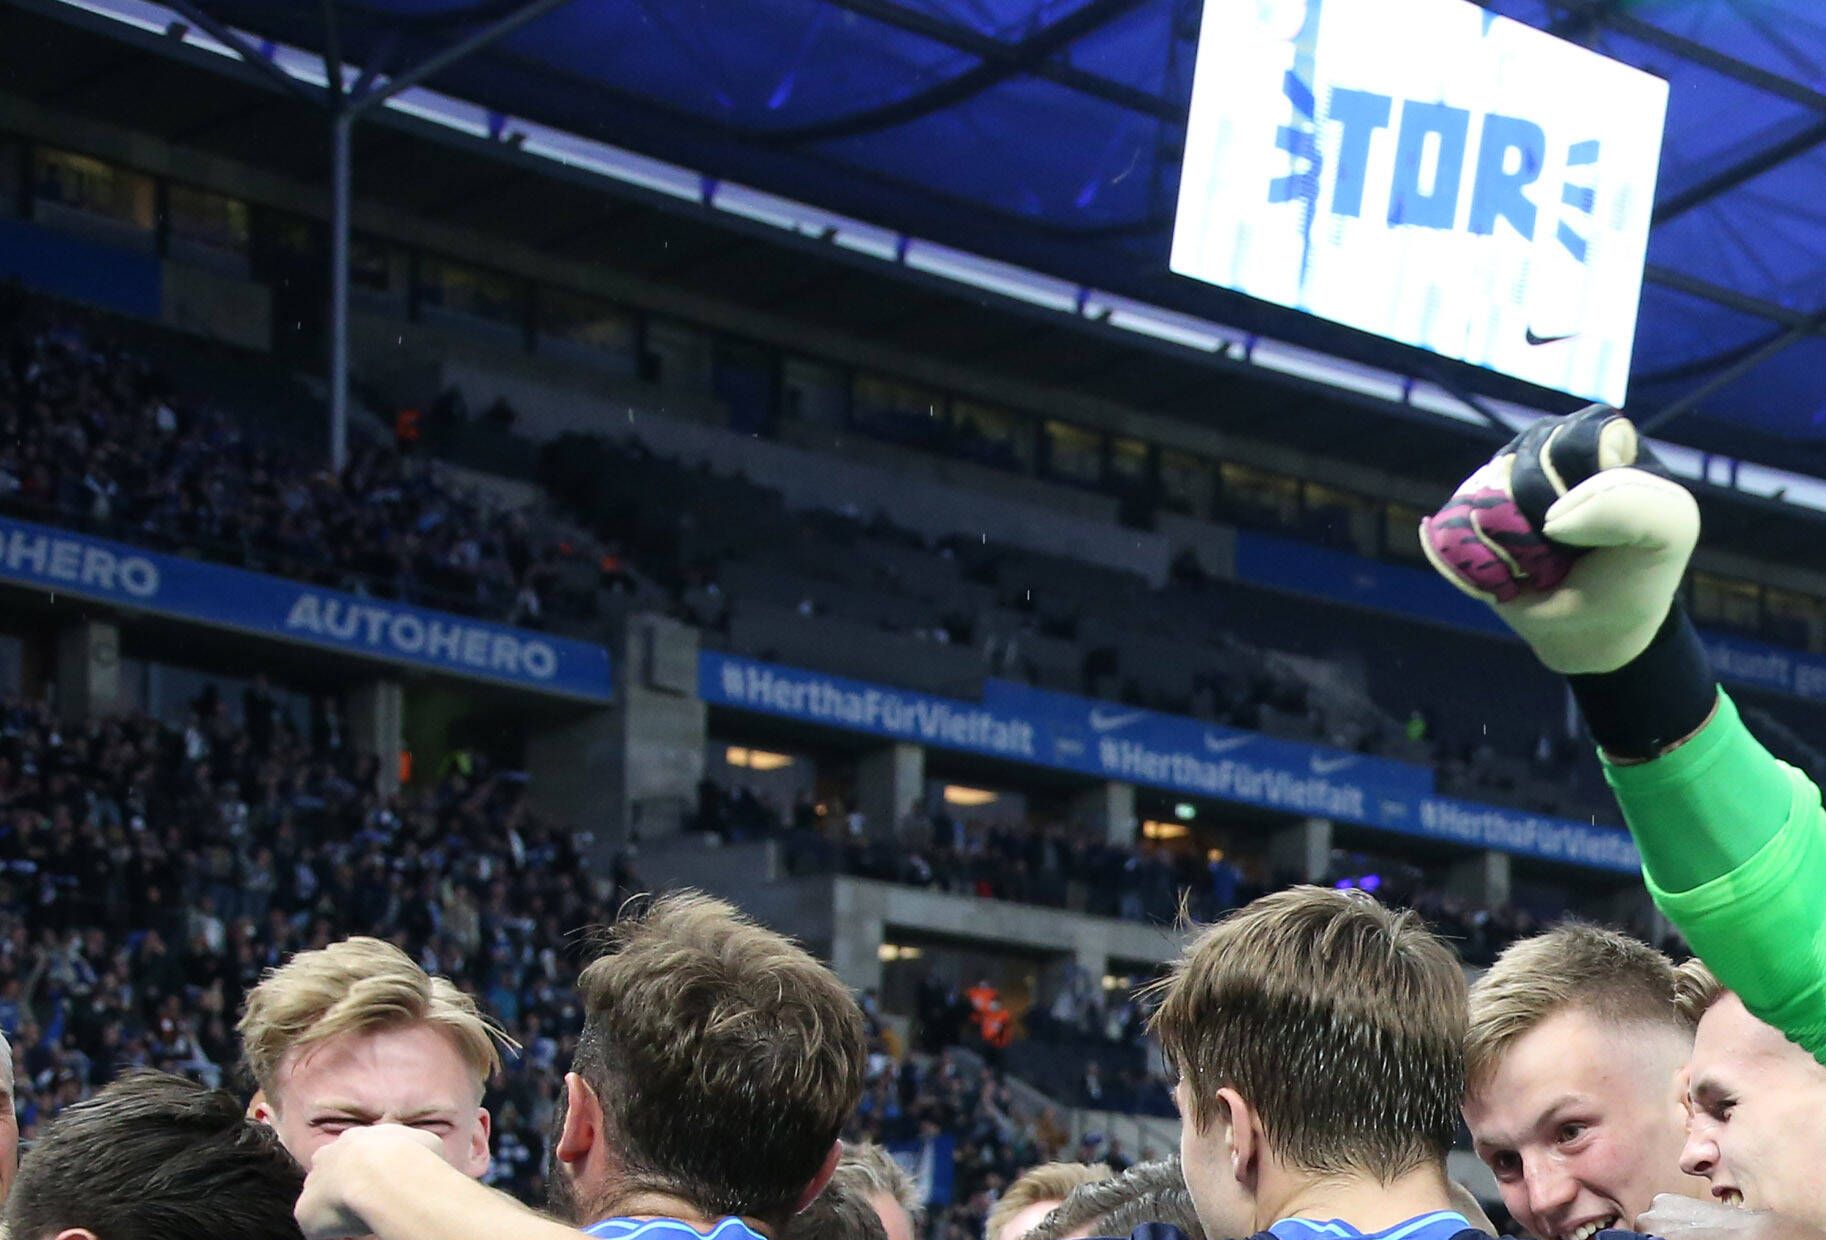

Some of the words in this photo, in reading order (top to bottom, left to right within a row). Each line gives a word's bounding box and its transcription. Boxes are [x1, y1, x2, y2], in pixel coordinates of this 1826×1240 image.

[1328, 86, 1546, 242] TOR
[0, 529, 160, 597] HERO
[286, 594, 559, 680] AUTOHERO
[722, 660, 1034, 756] #HerthaFürVielfalt
